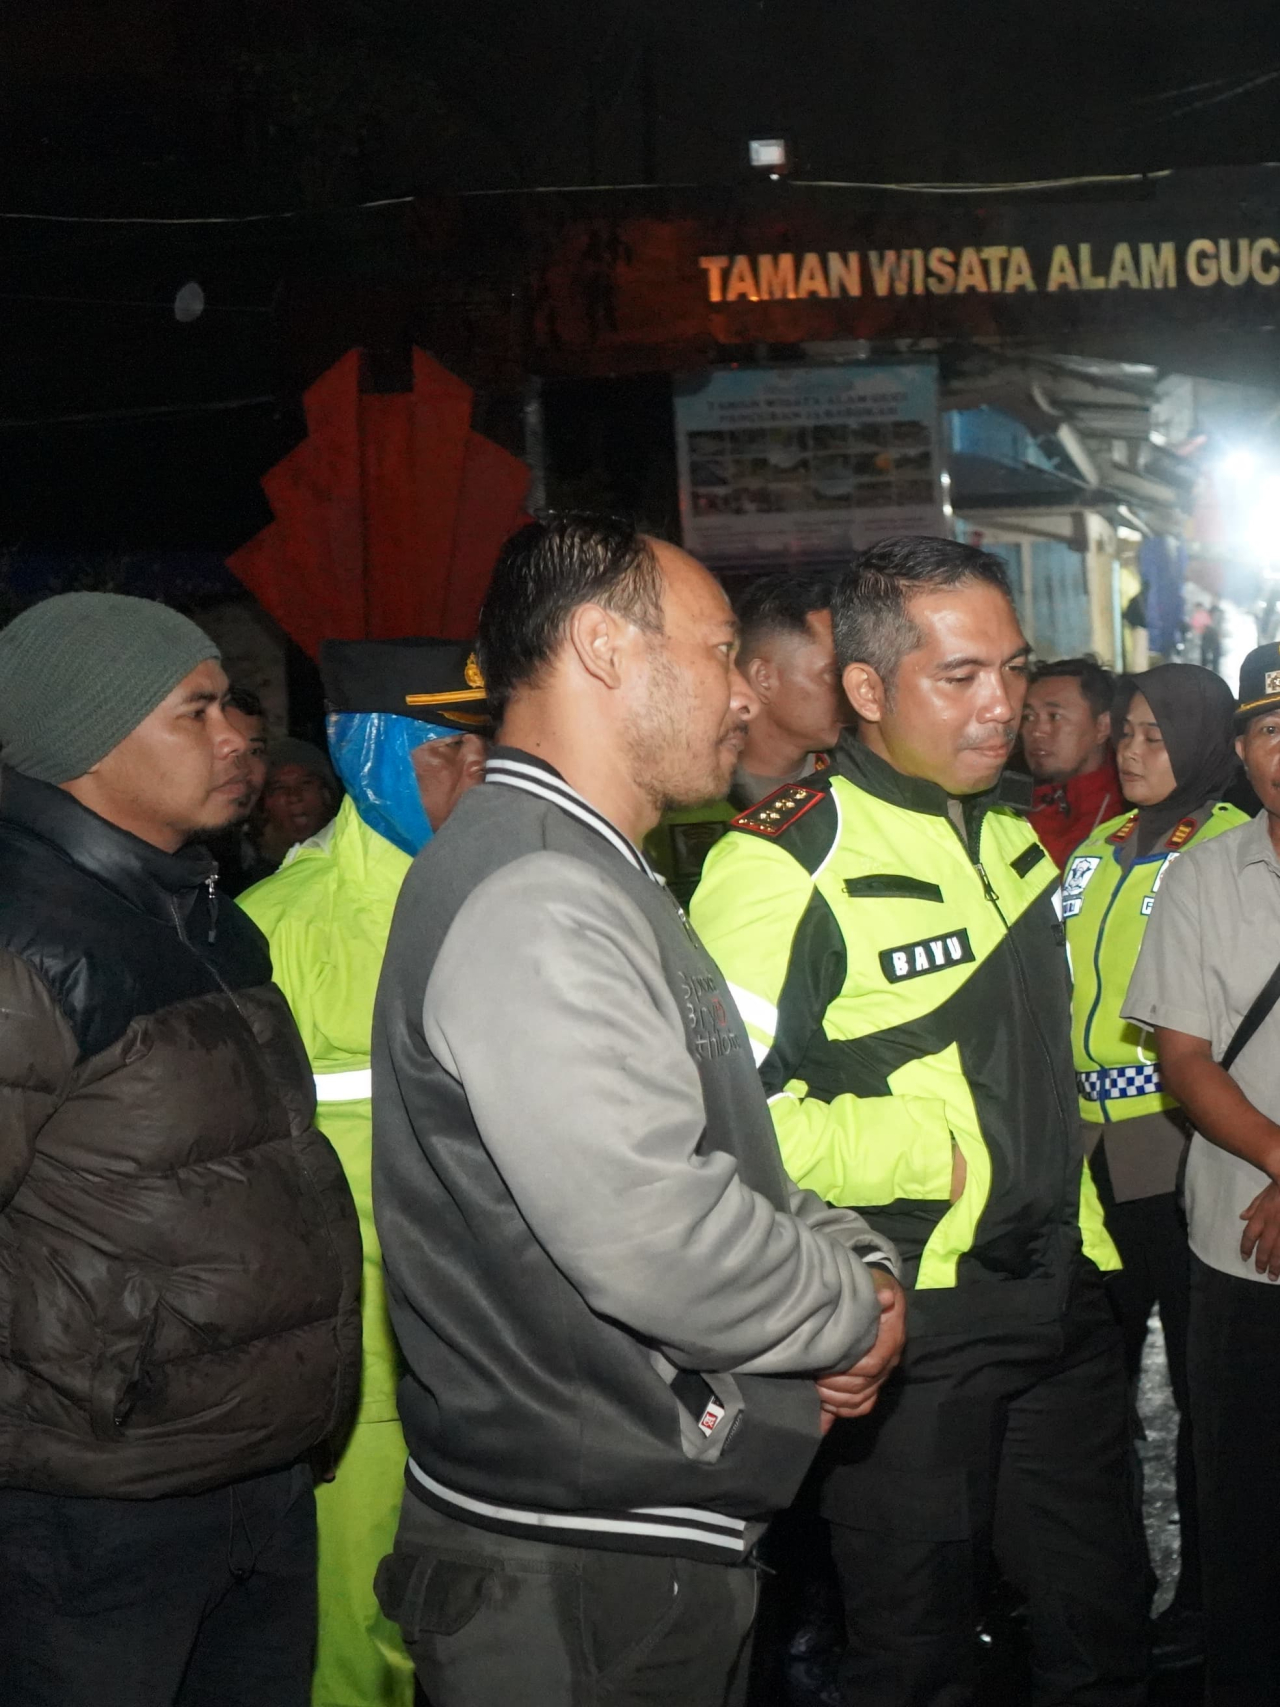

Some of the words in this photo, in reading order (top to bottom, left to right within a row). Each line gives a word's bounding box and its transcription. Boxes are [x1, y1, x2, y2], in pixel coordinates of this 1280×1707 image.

[700, 251, 862, 302] TAMAN
[869, 245, 1035, 296] WISATA
[1048, 241, 1176, 290] ALAM
[893, 936, 963, 976] BAYU
